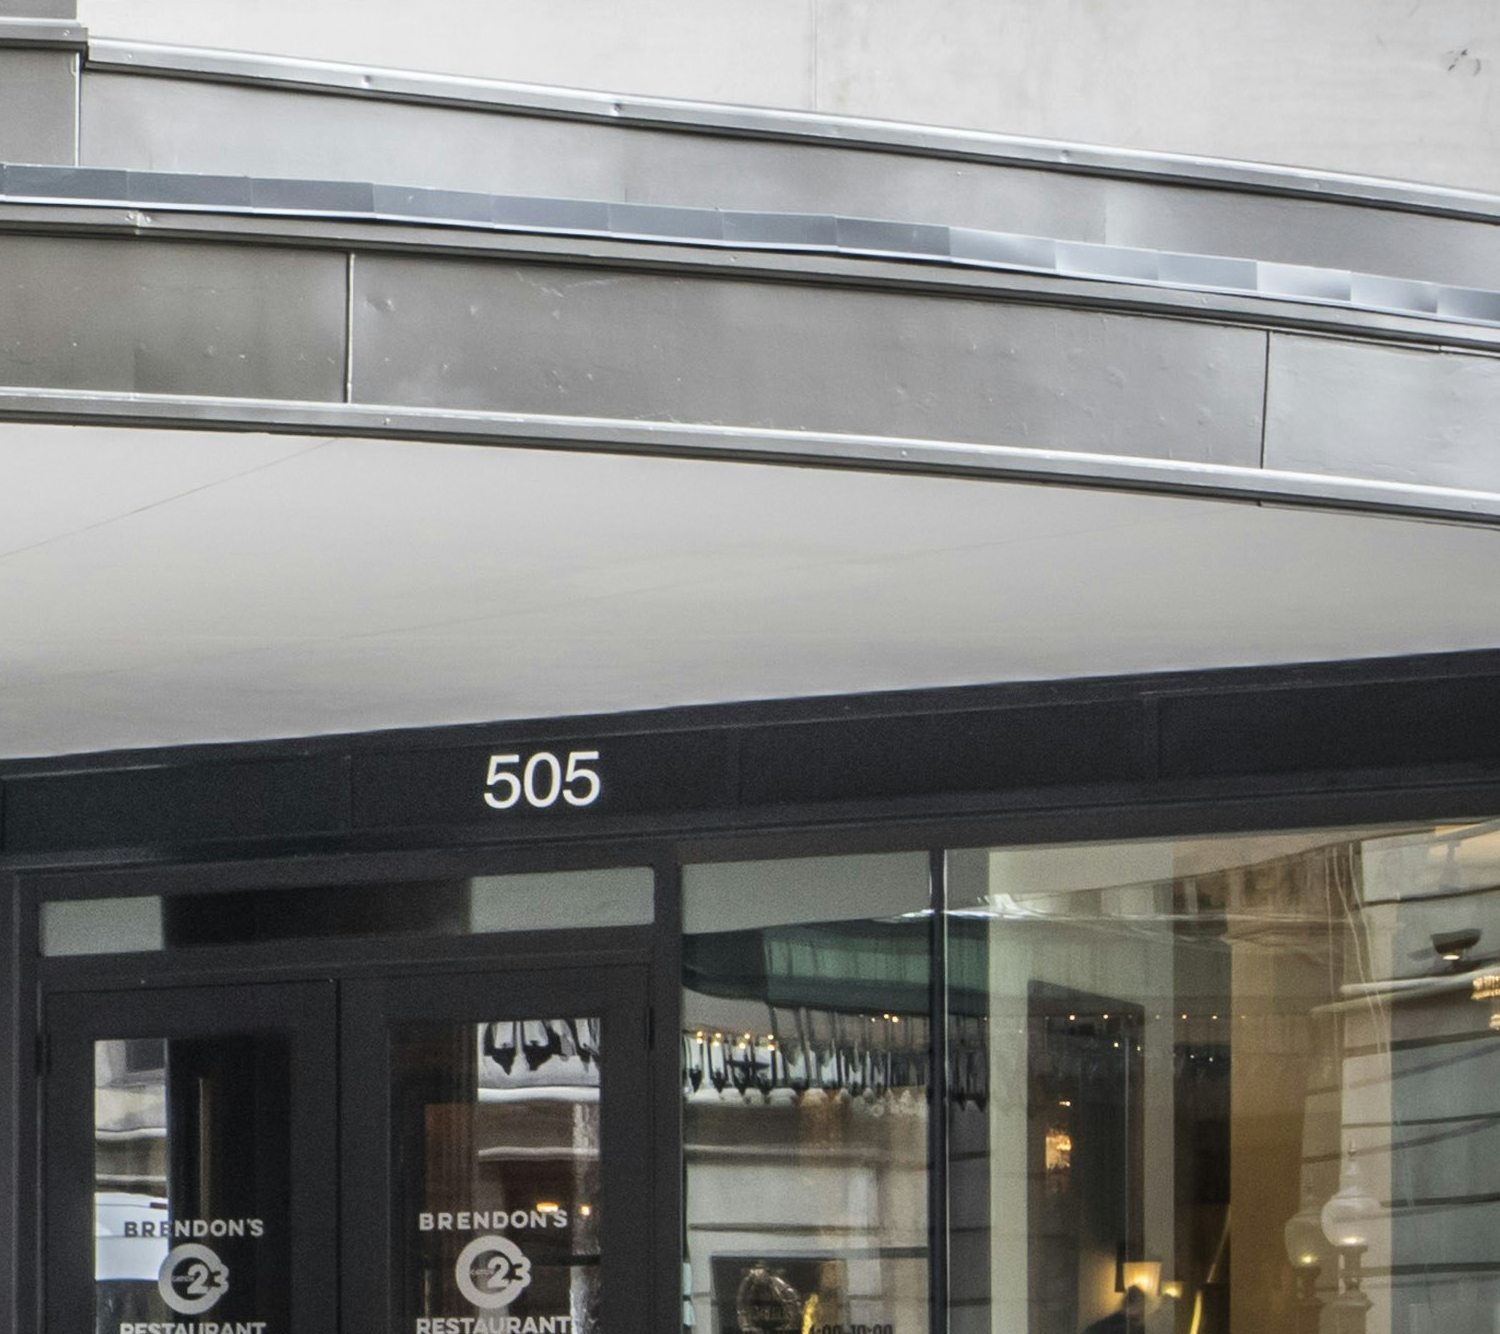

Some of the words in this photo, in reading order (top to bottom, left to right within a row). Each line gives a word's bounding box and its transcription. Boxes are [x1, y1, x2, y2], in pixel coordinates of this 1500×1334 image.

[484, 750, 601, 809] 505
[124, 1219, 264, 1238] BRENDON'S
[419, 1210, 568, 1231] BRENDON'S
